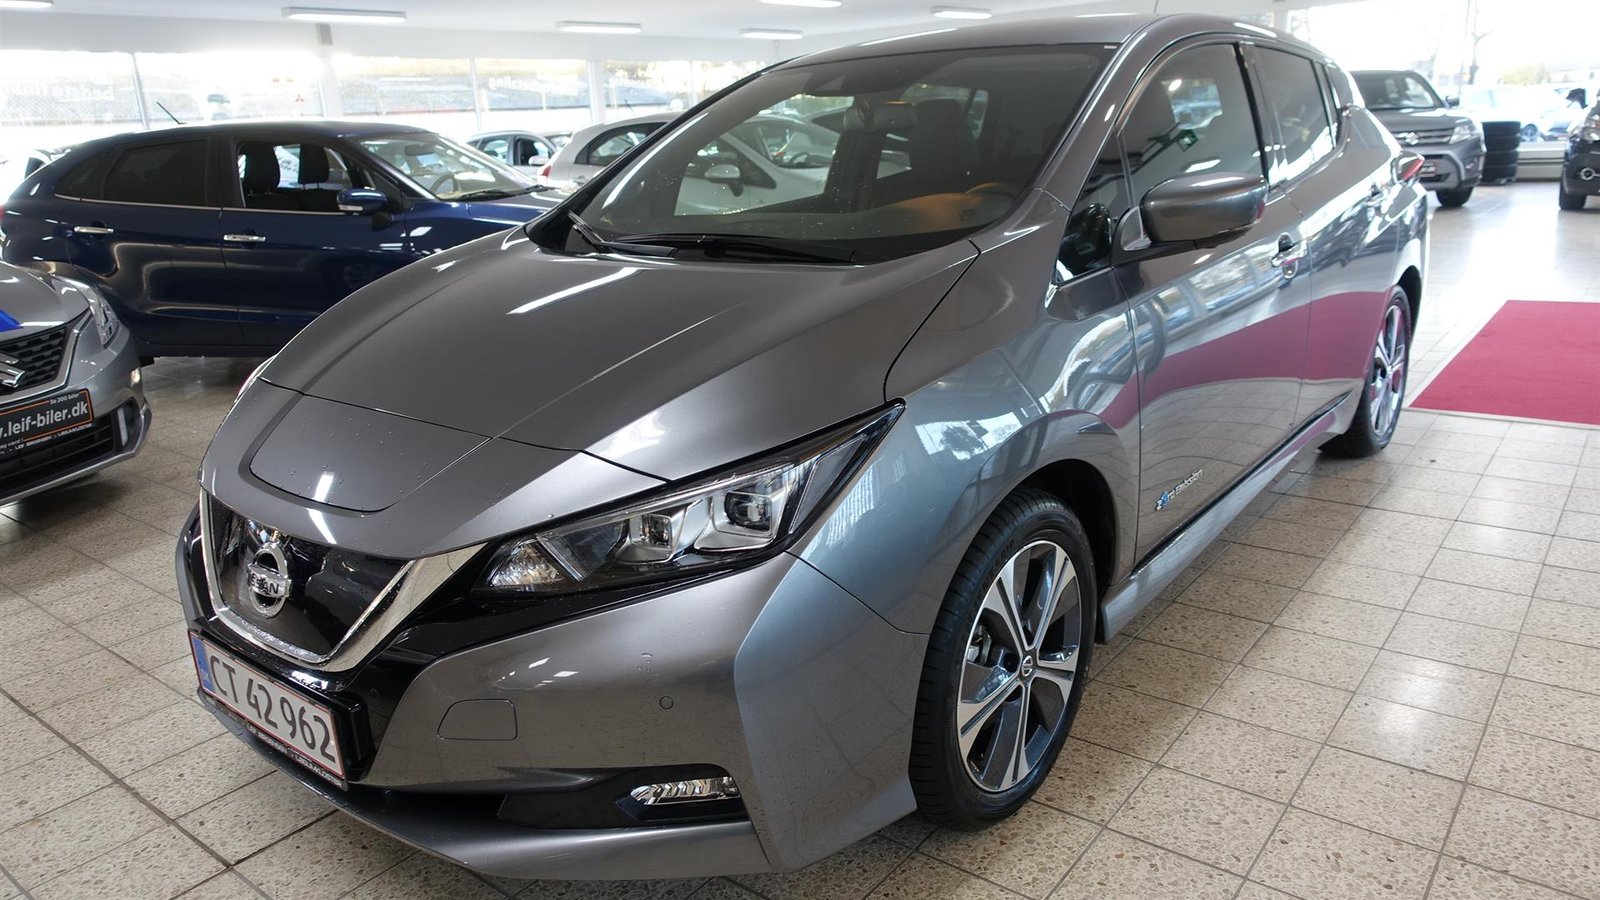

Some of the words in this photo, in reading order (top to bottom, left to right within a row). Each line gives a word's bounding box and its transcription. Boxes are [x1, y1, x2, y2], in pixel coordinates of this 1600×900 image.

[210, 655, 239, 703] CT
[246, 677, 278, 729] 42
[280, 696, 336, 763] 962
